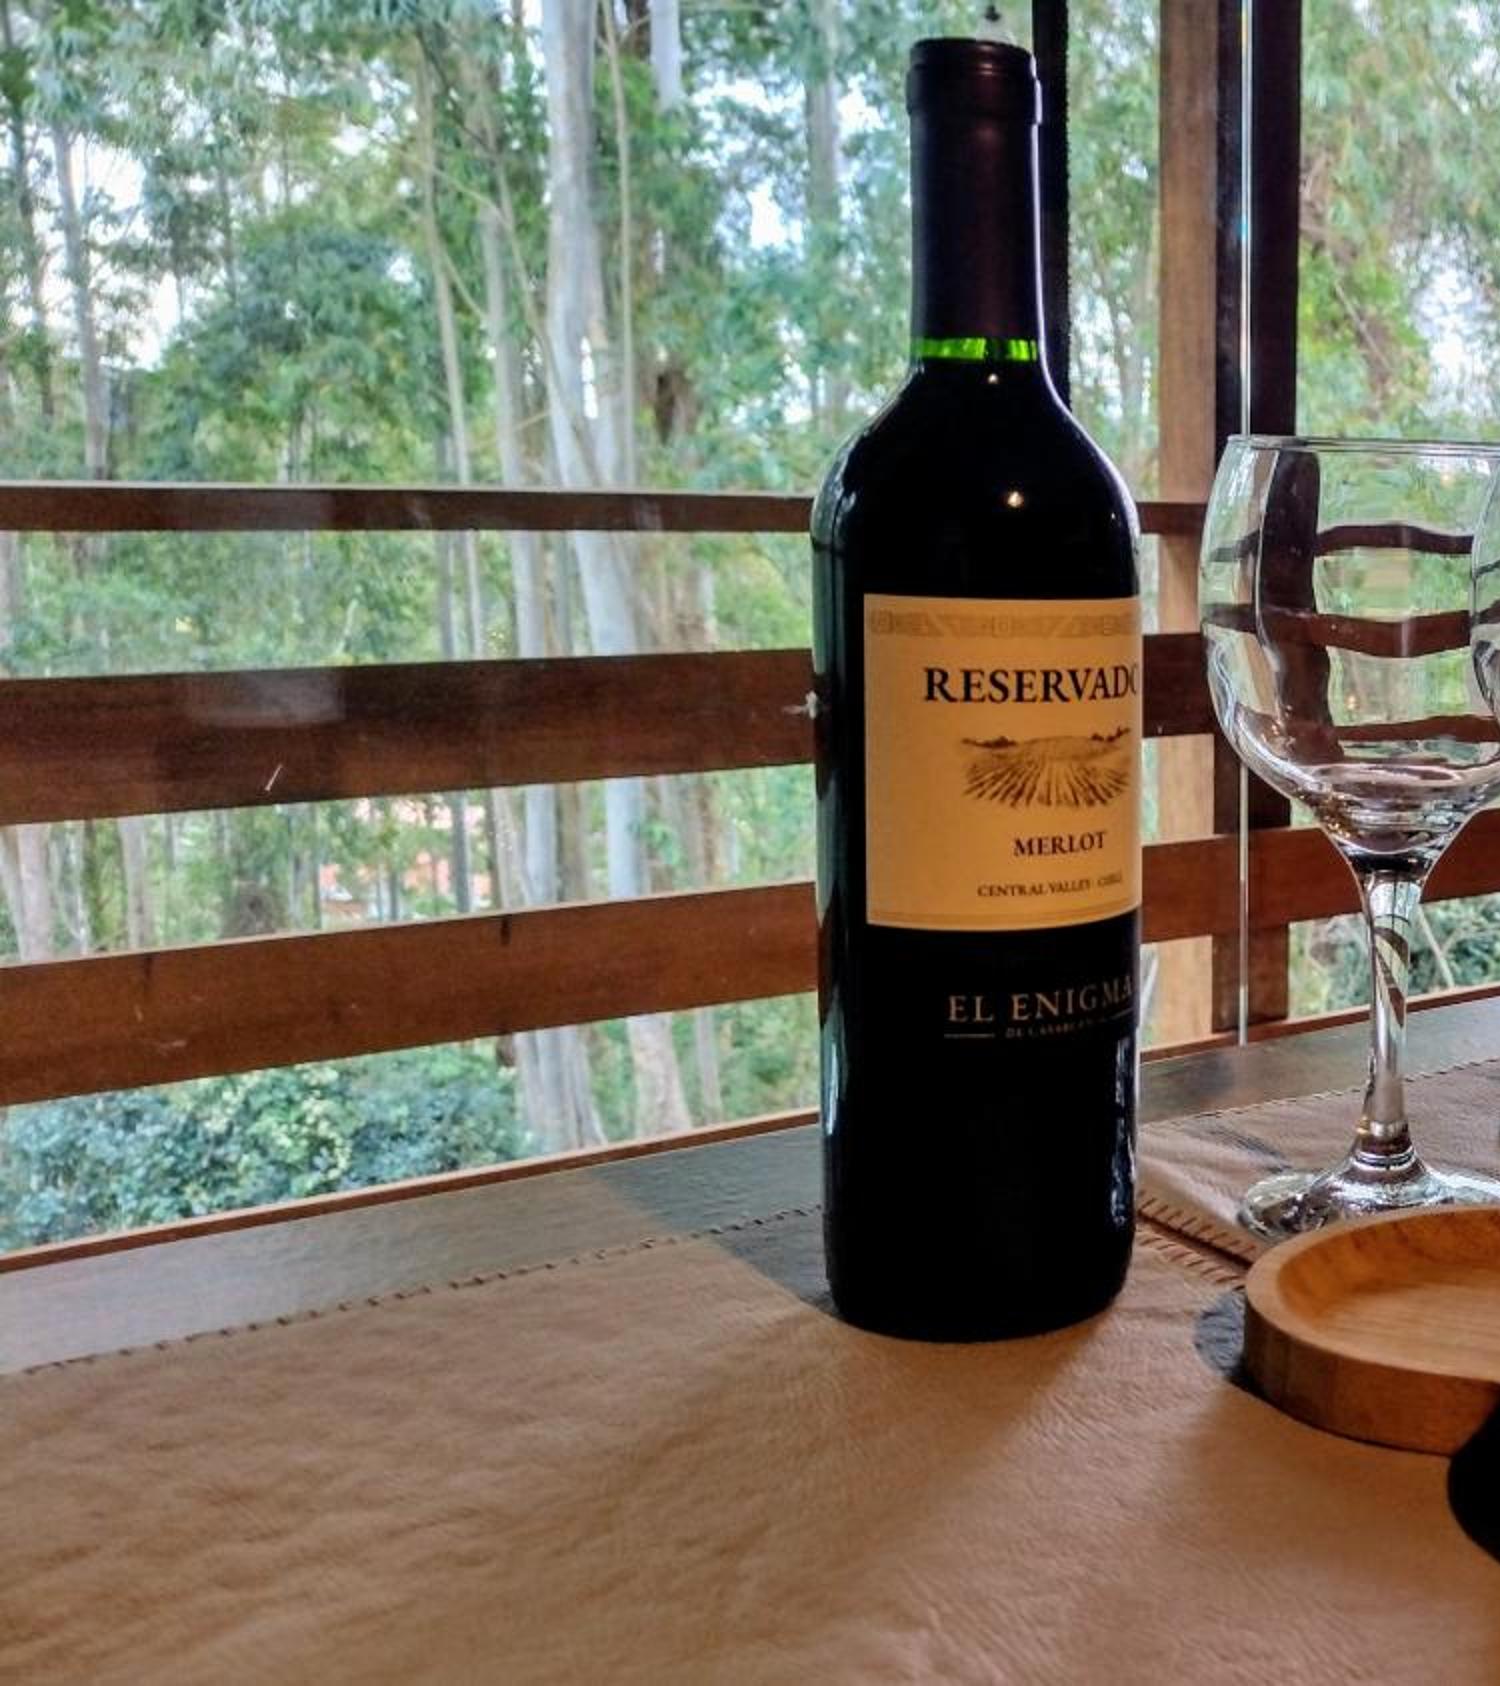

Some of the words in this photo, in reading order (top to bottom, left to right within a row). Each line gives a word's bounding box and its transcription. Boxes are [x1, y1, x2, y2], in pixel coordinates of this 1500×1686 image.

[1013, 832, 1106, 857] MERLOT
[977, 883, 1047, 897] CENTRAL
[1048, 879, 1091, 893] VALLEY
[948, 995, 994, 1022] EL
